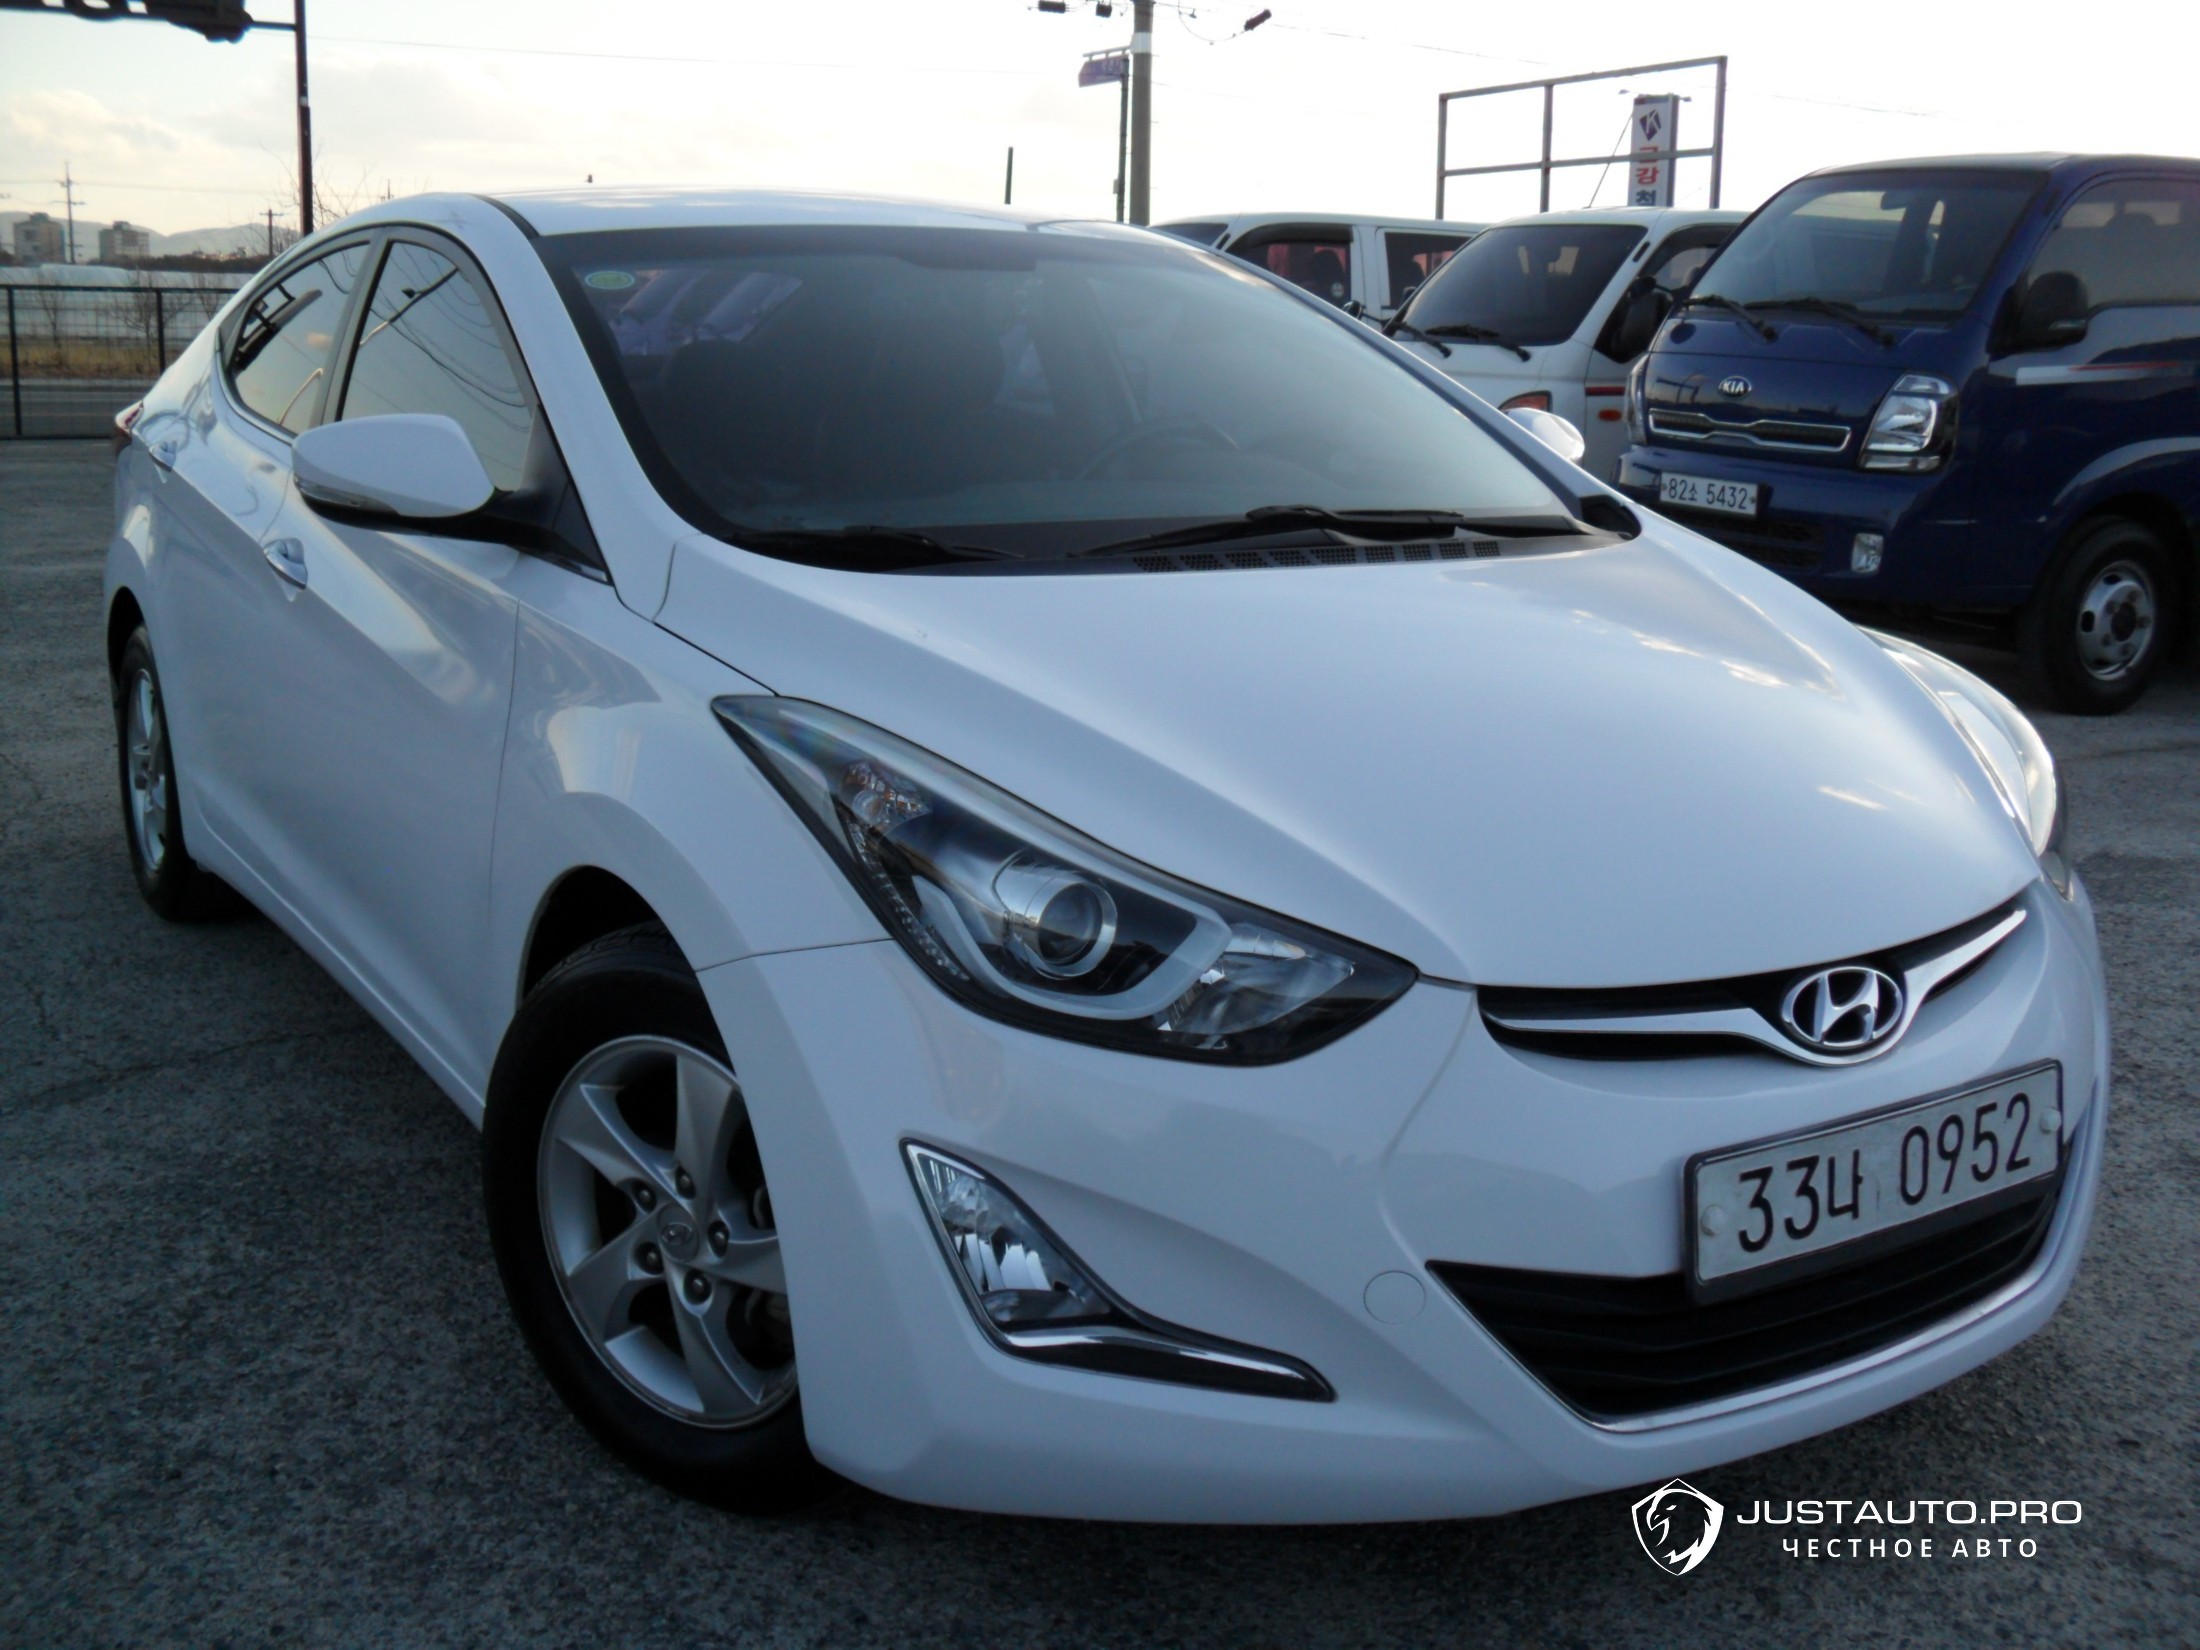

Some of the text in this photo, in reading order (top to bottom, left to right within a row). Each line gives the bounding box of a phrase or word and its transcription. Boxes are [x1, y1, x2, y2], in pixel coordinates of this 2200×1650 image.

[1723, 380, 1745, 393] KIA
[1668, 478, 1748, 510] 82소 5432
[1738, 1092, 2031, 1253] 33나 0952
